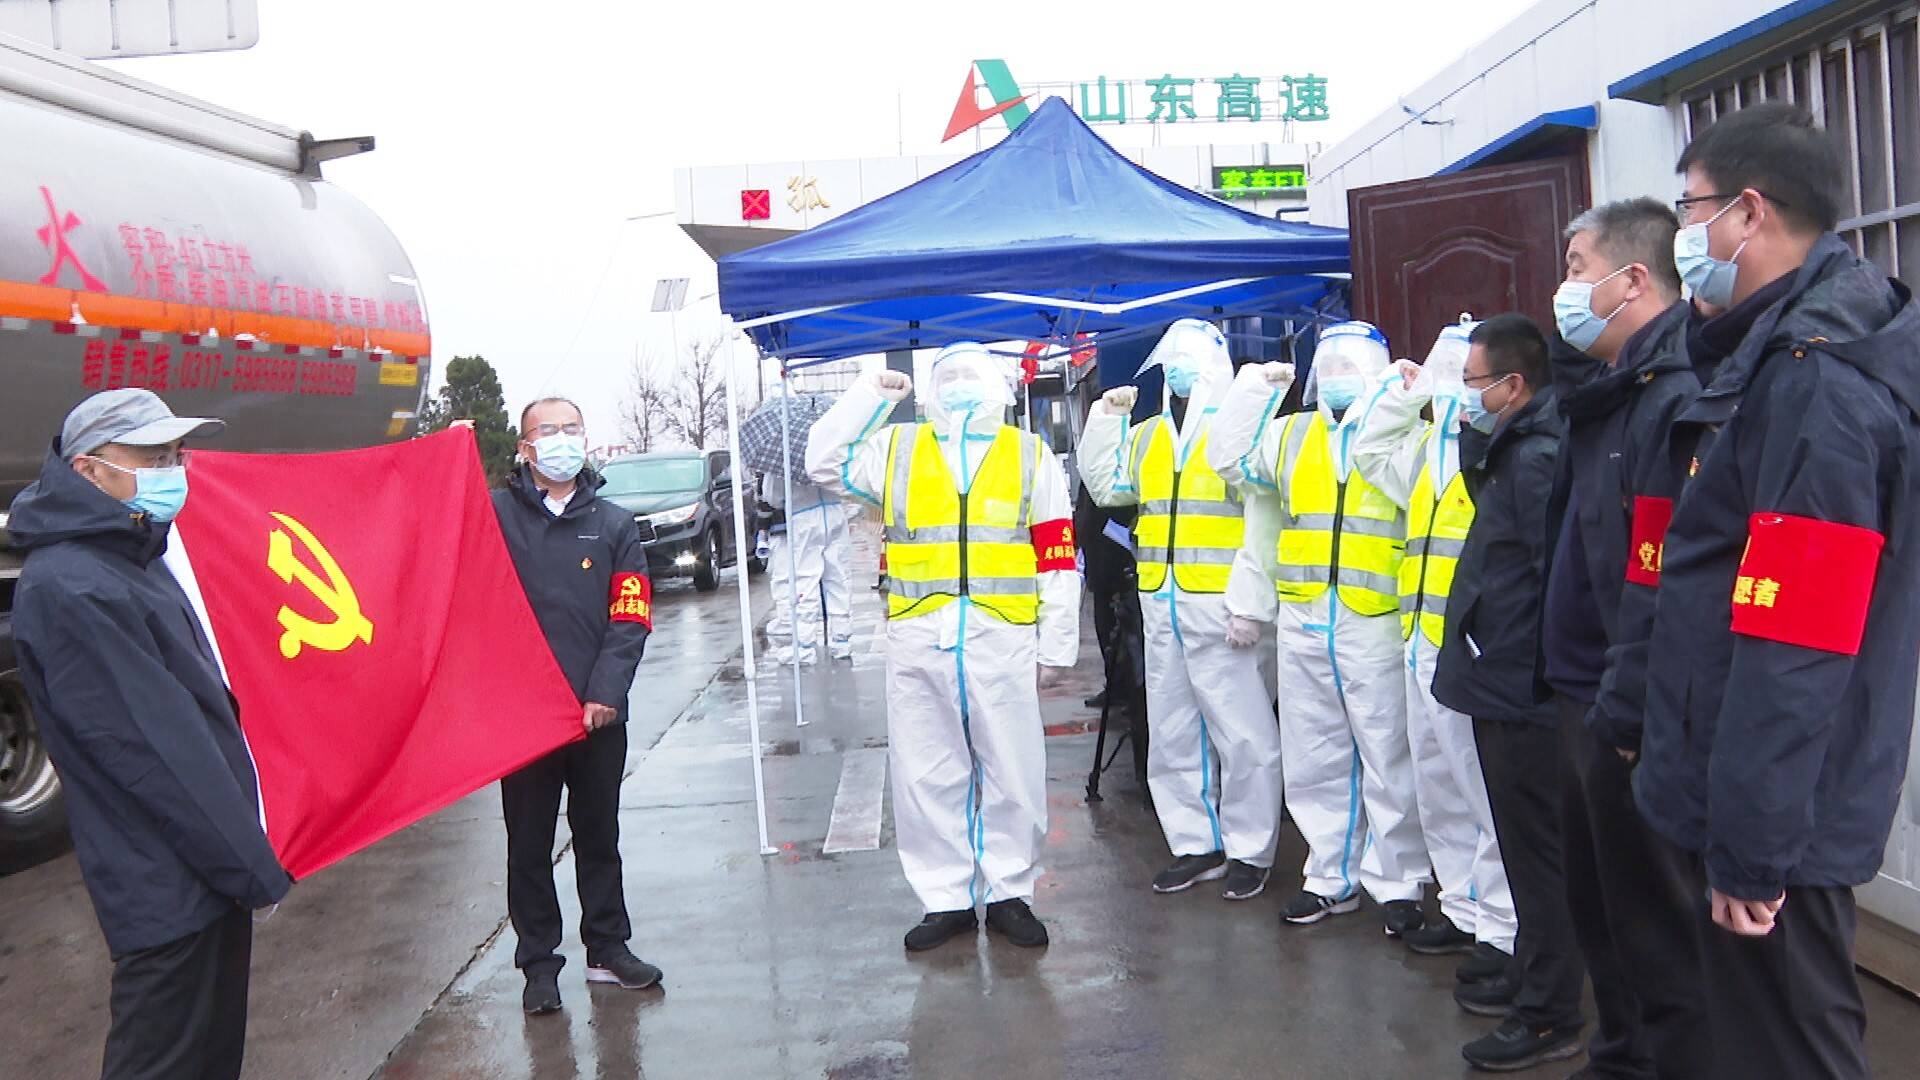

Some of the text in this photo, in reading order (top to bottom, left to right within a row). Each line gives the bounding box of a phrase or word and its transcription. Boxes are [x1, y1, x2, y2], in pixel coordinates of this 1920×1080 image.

[1081, 73, 1329, 124] 山东高速
[1220, 168, 1308, 197] 客车ET
[36, 185, 110, 292] 火
[1638, 541, 1663, 573] 党
